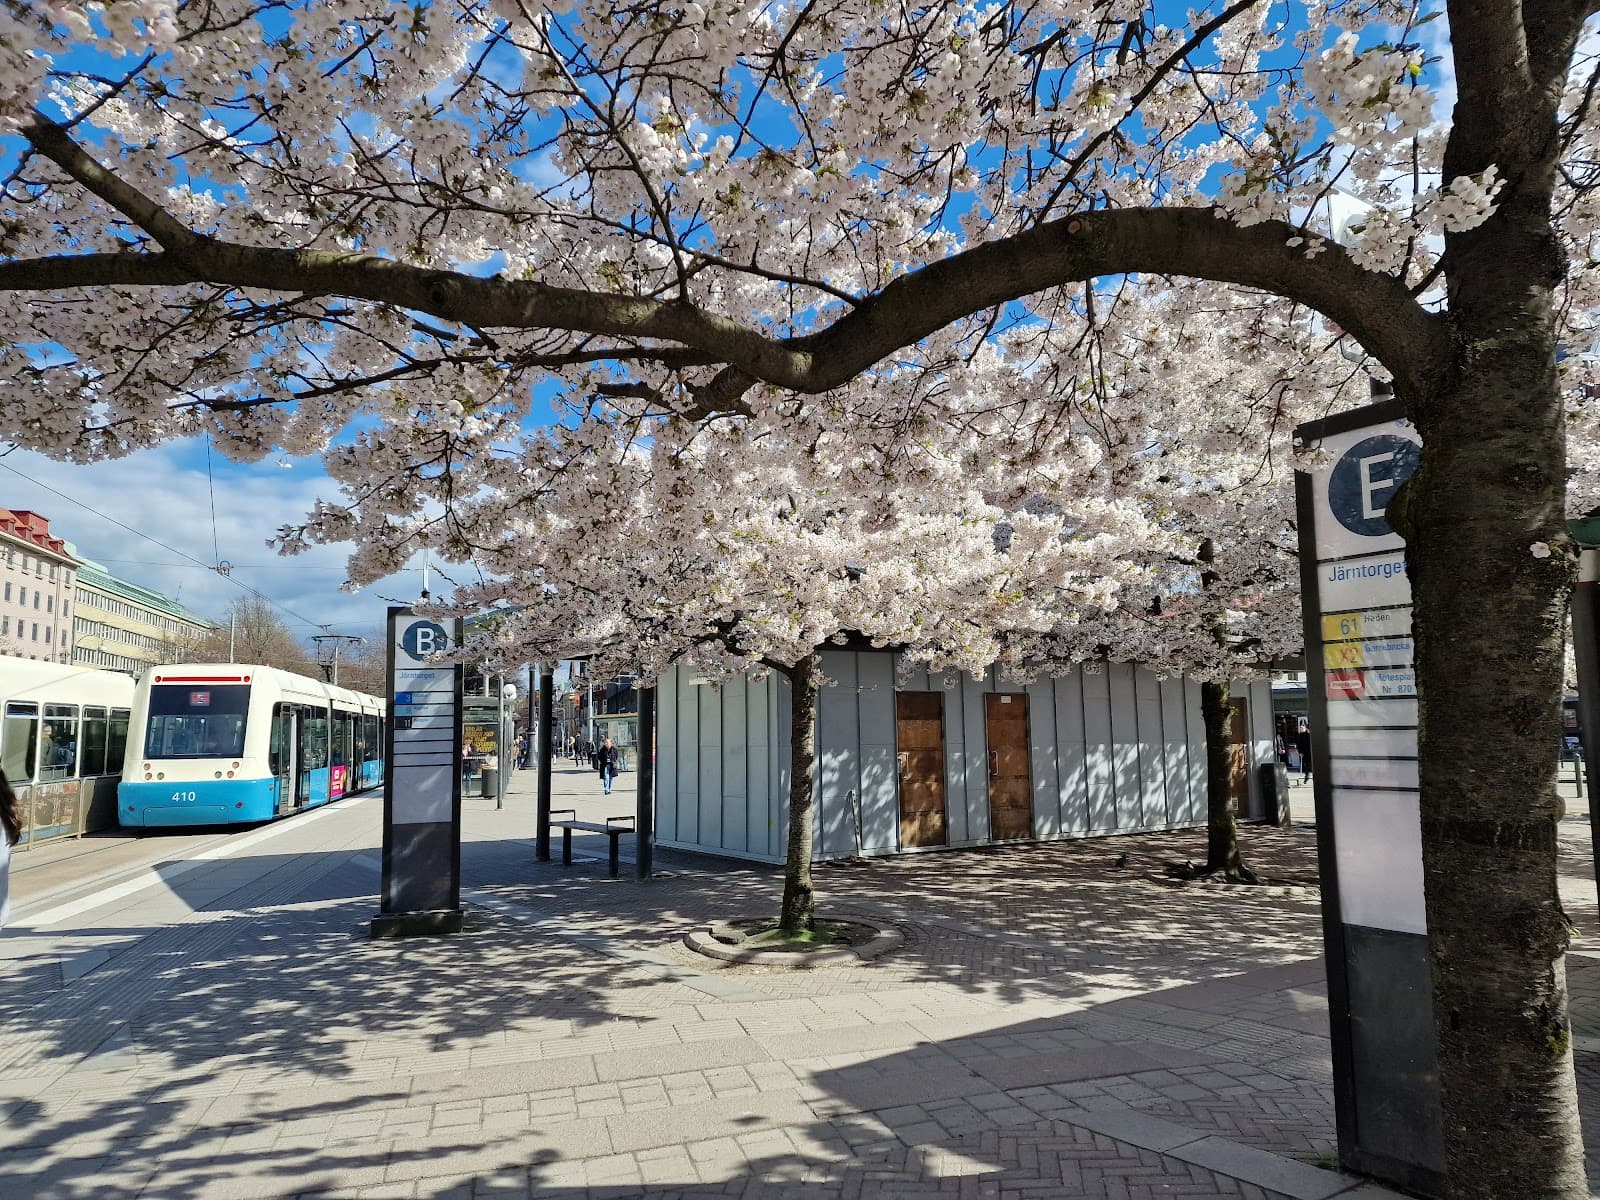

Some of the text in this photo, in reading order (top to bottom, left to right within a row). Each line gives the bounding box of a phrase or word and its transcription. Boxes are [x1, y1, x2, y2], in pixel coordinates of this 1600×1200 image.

[1359, 451, 1394, 520] E
[1340, 617, 1357, 635] 61
[1364, 613, 1391, 623] Heden
[416, 628, 436, 655] B
[1340, 647, 1359, 664] X2
[171, 791, 196, 802] 410
